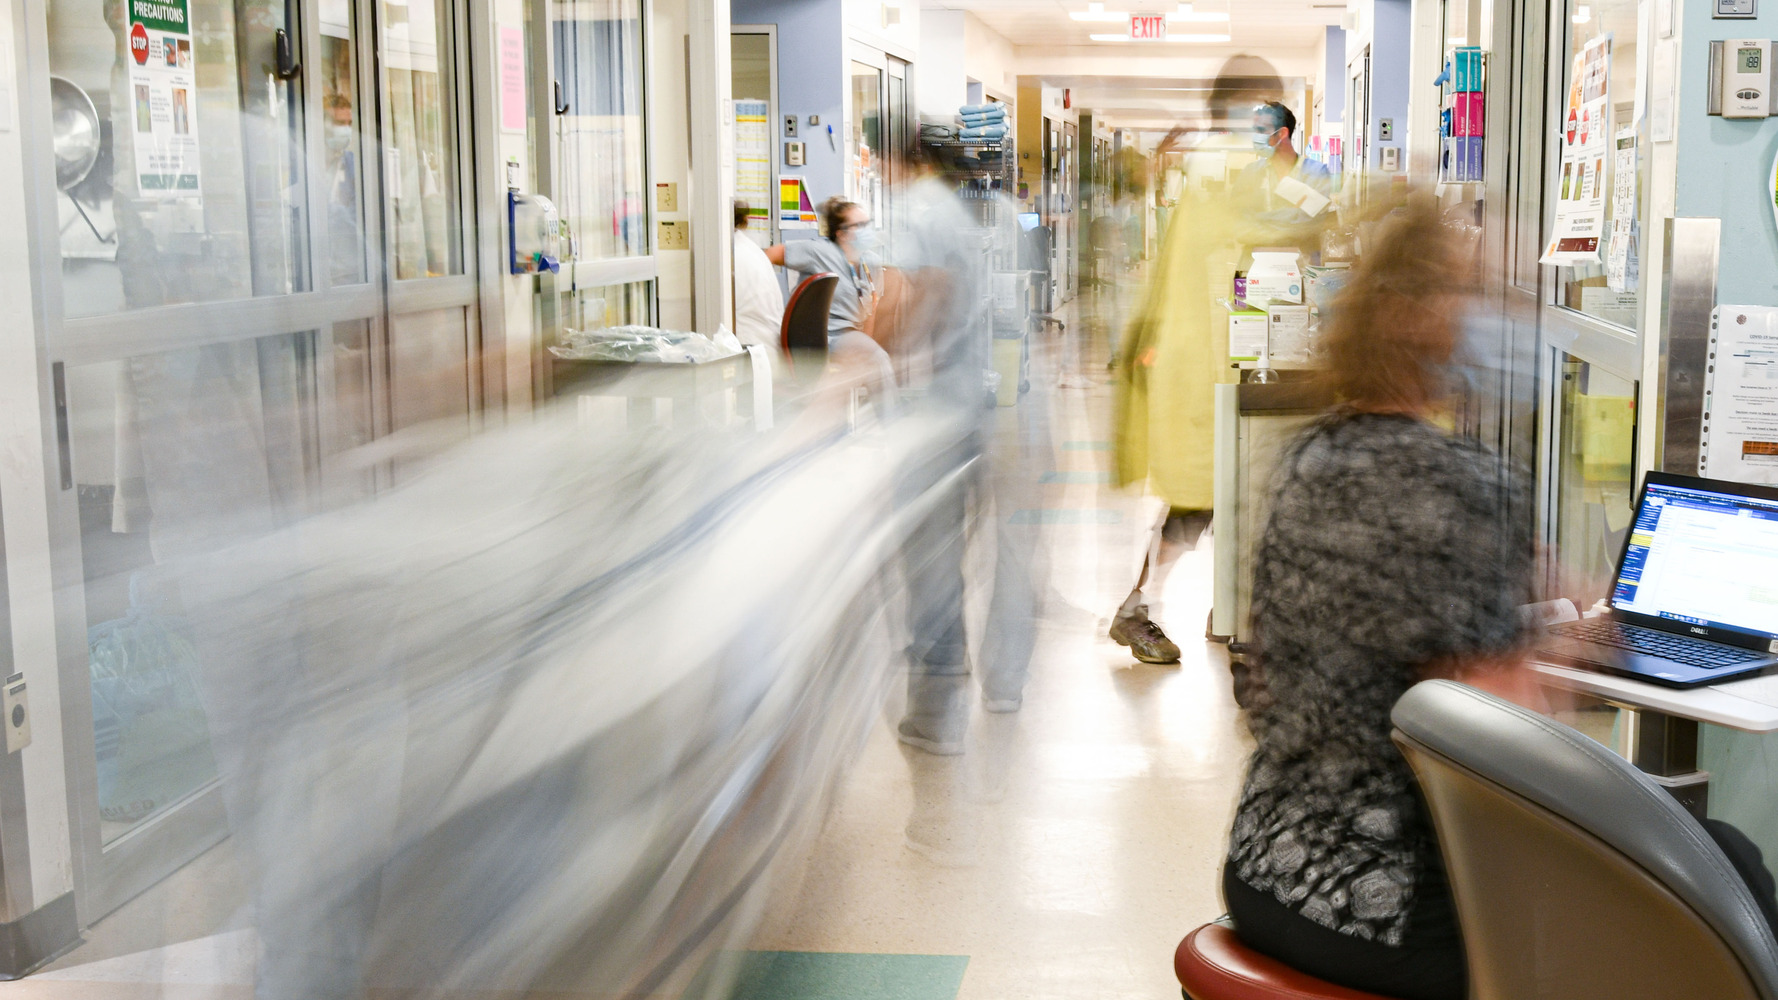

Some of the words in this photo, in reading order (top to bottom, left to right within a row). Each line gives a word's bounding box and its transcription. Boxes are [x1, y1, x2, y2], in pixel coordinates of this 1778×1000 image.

[133, 1, 184, 24] PRECAUTIONS
[1132, 16, 1162, 38] EXIT
[132, 36, 147, 50] STOP
[1690, 626, 1708, 635] DELL
